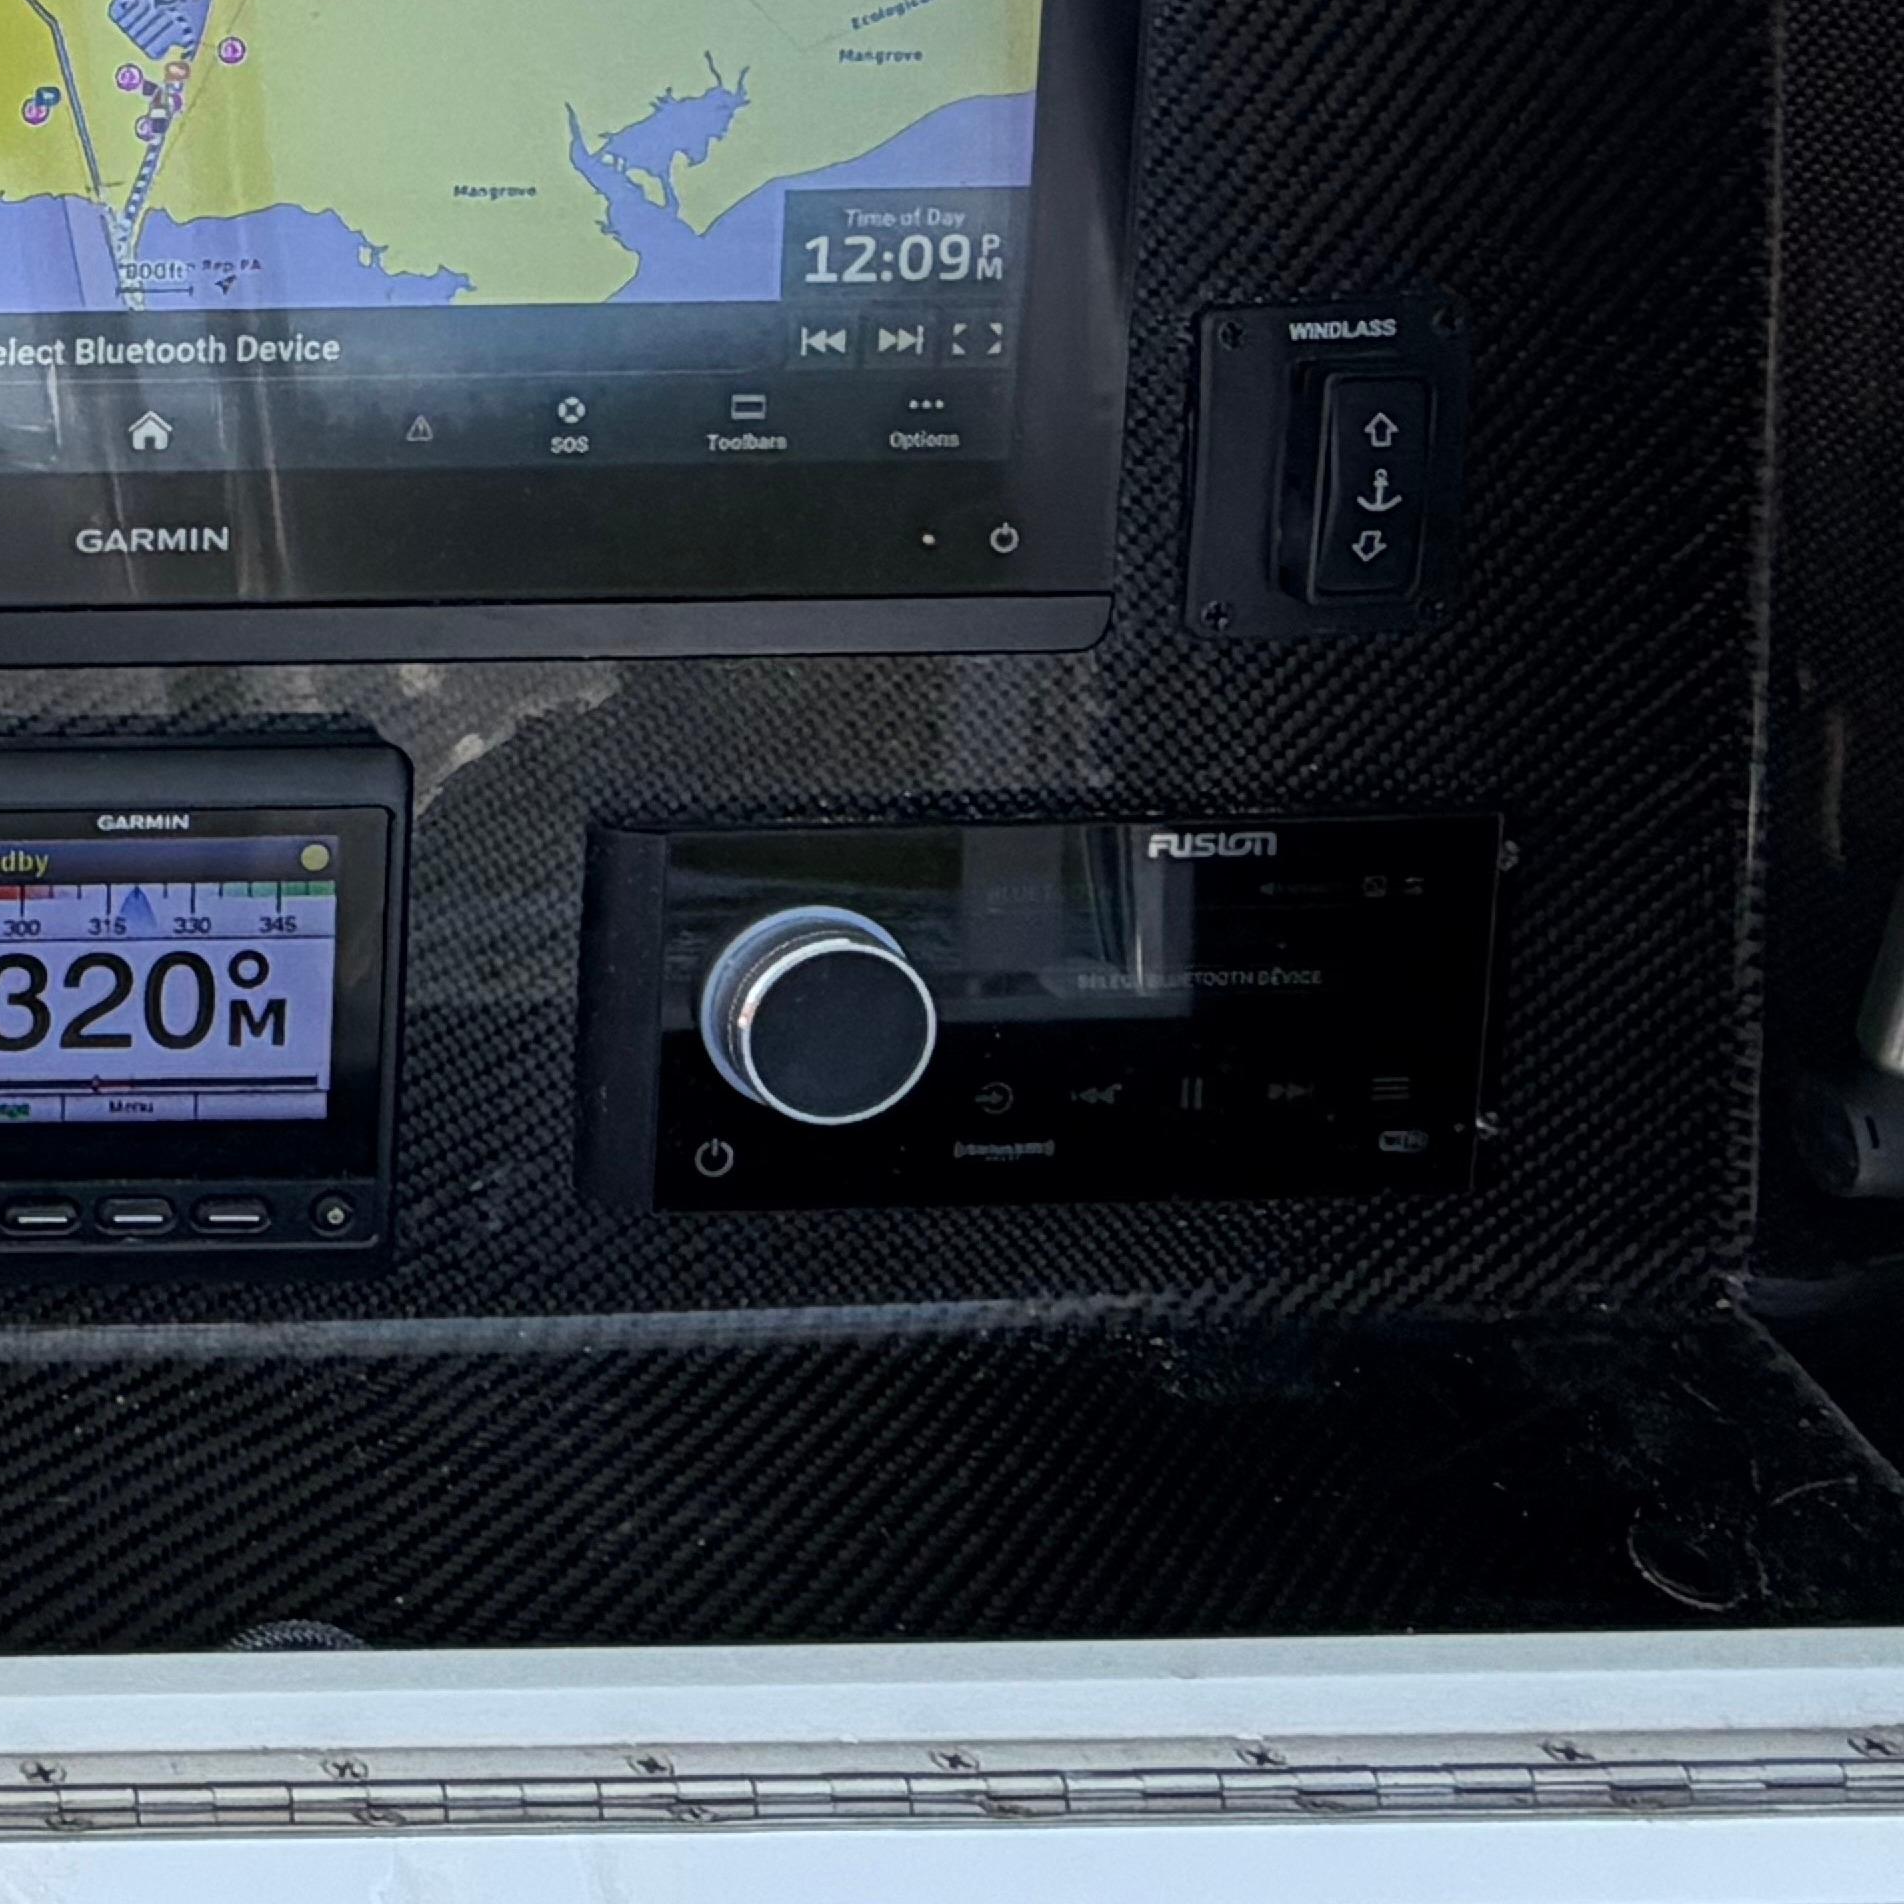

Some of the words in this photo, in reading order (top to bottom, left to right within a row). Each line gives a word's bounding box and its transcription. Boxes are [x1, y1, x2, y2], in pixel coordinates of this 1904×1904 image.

[839, 48, 923, 66] Mangrove
[846, 209, 895, 229] Time
[900, 208, 923, 228] of
[926, 208, 967, 230] Day
[803, 233, 971, 284] 12:09
[1289, 318, 1397, 341] WINDLASS
[74, 336, 227, 366] Bluetooth
[237, 335, 342, 364] Device
[550, 435, 591, 455] SOS
[706, 433, 788, 452] Toolbars
[889, 431, 961, 452] Options
[75, 527, 231, 553] GARMIN
[96, 813, 191, 832] GARMIN
[1148, 831, 1278, 859] FUSION
[3, 919, 42, 938] 300
[88, 917, 128, 937] 315
[173, 916, 212, 935] 330
[259, 915, 298, 934] 345
